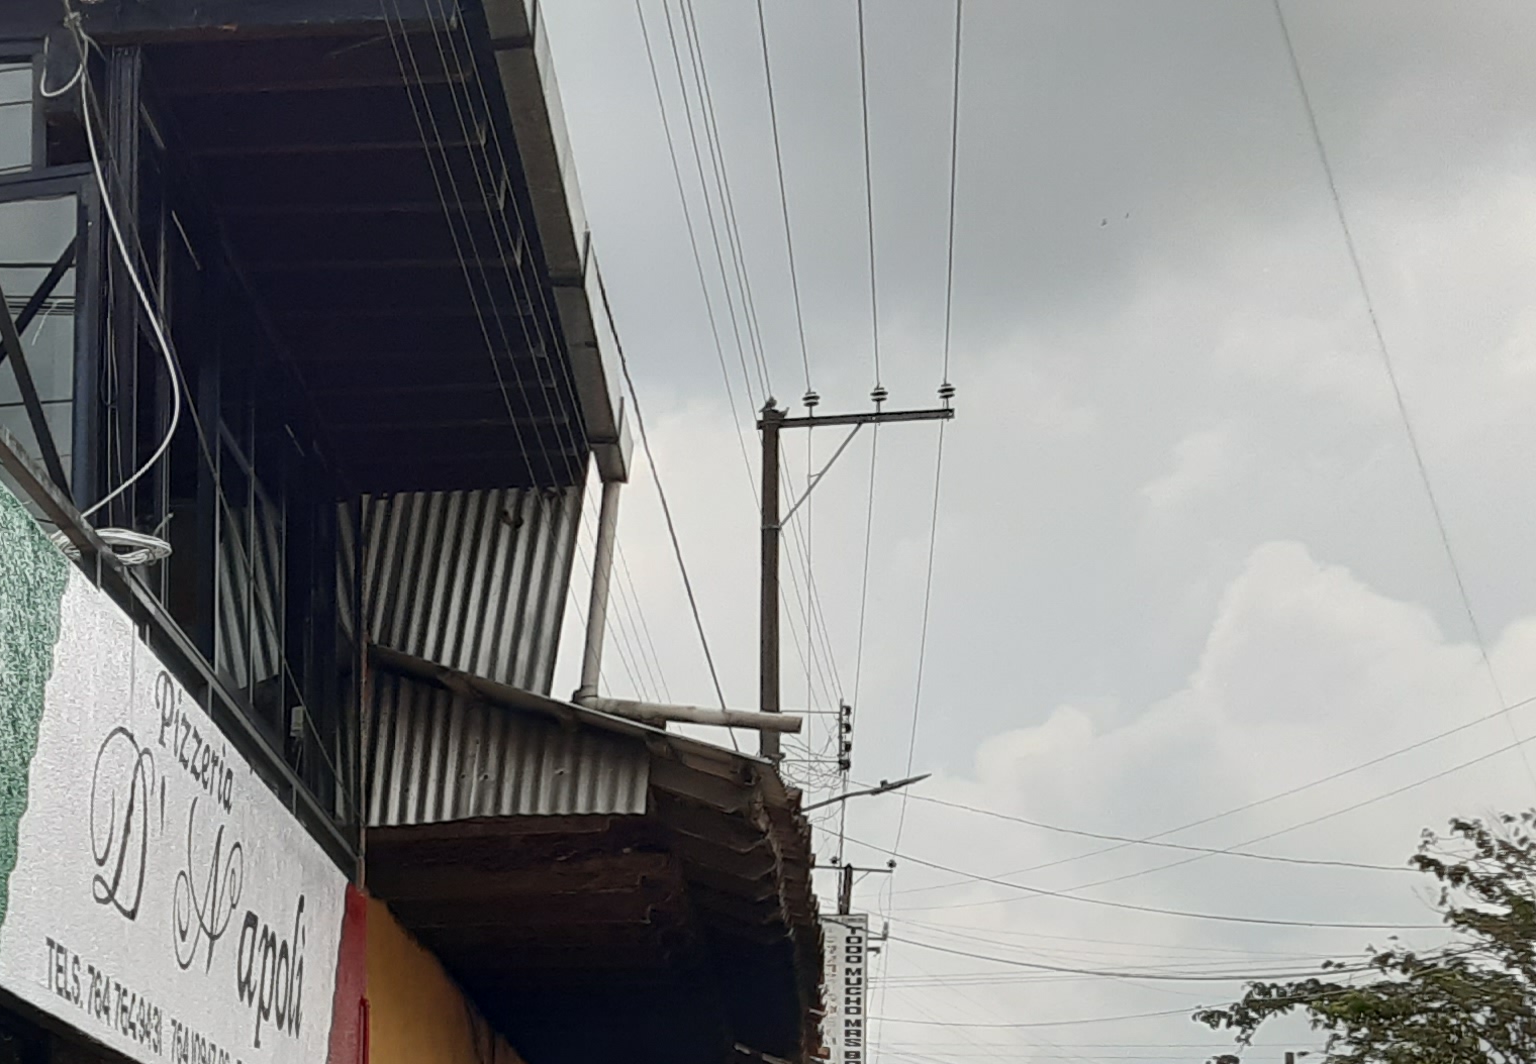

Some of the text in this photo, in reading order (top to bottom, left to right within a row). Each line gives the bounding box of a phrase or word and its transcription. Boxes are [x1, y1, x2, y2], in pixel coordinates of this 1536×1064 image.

[154, 670, 234, 815] Pizzeria
[845, 926, 863, 964] TODO
[46, 936, 83, 1008] TELS.
[88, 964, 111, 1026] 764
[844, 967, 862, 1015] MUCHO
[844, 1019, 862, 1047] MAS
